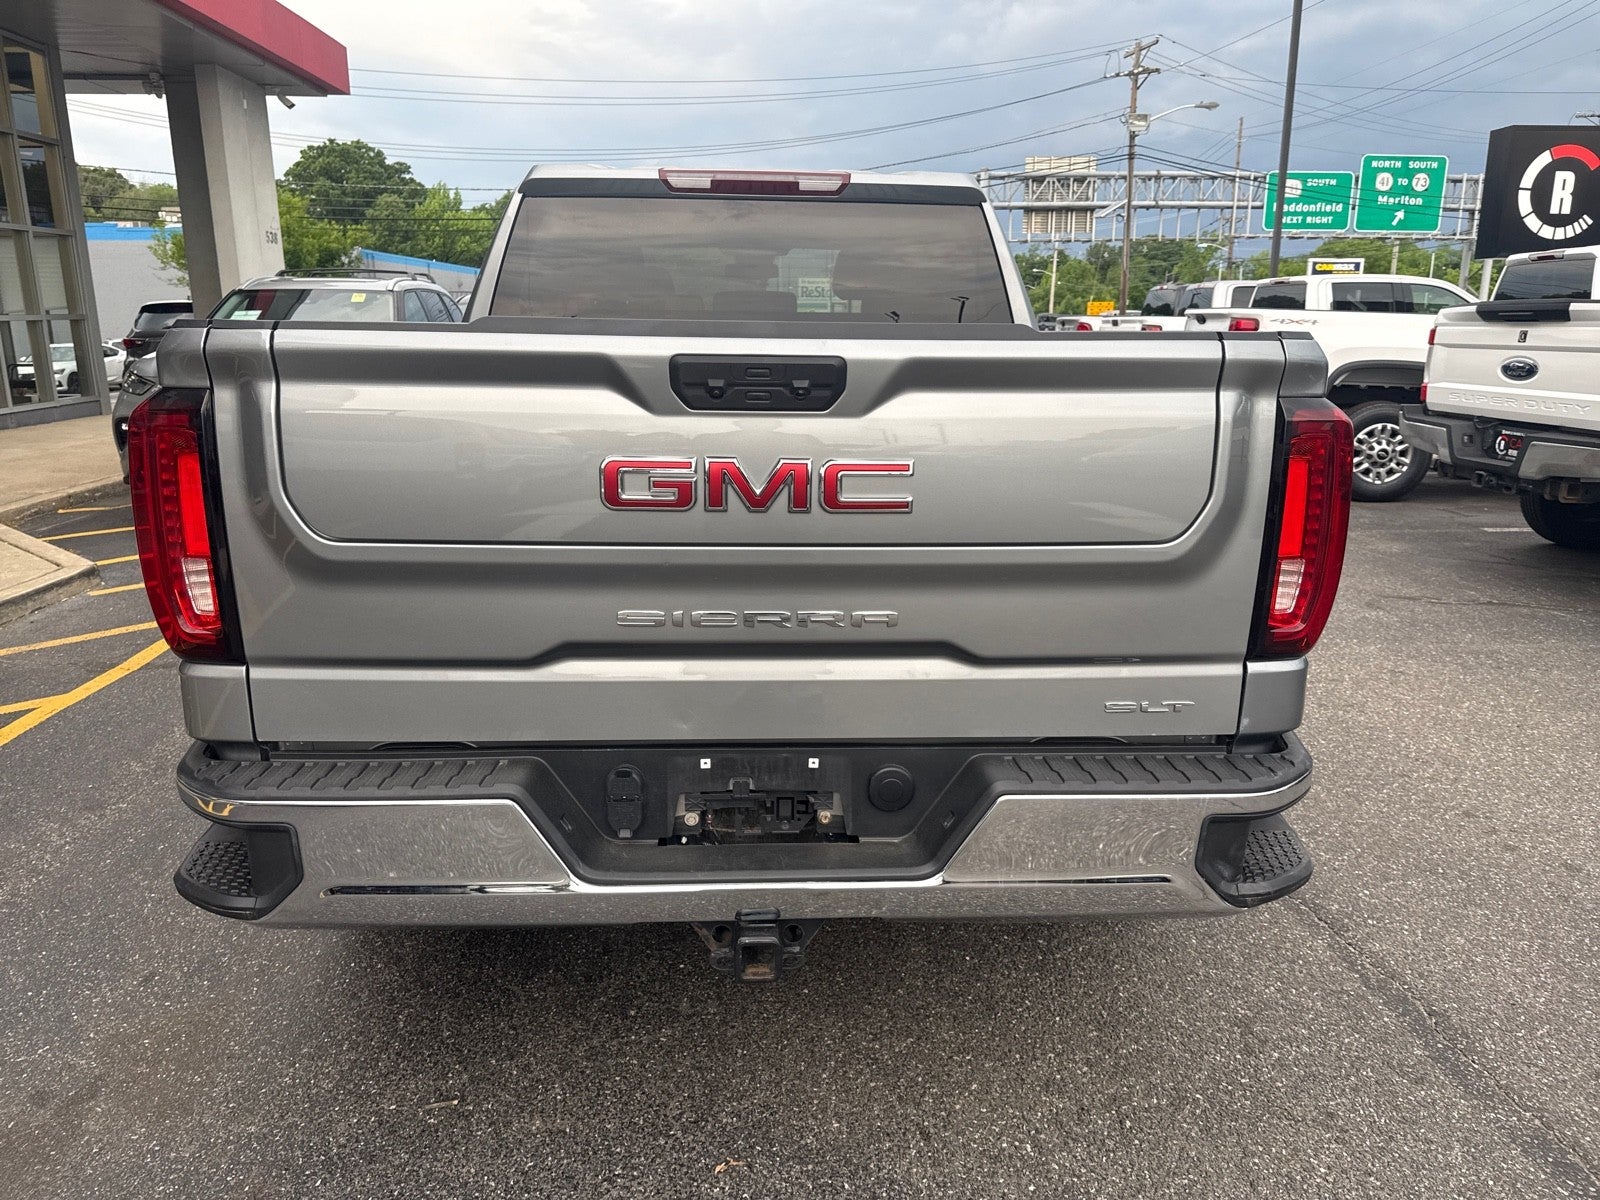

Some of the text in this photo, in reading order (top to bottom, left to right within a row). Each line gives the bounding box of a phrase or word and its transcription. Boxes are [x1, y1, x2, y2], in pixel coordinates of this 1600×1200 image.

[1371, 160, 1438, 169] NORTH SOUTH
[1306, 178, 1337, 187] SOUTH
[1378, 177, 1427, 187] 41 TO 73
[1549, 170, 1576, 215] R
[1377, 195, 1423, 206] Marlton
[1273, 202, 1343, 212] addonfield
[1306, 216, 1333, 224] RIGHT
[265, 230, 278, 245] 538
[1449, 392, 1592, 415] SUPER DUTY
[600, 455, 914, 513] GMC
[617, 610, 899, 628] SIERRA
[1104, 701, 1196, 713] SLT
